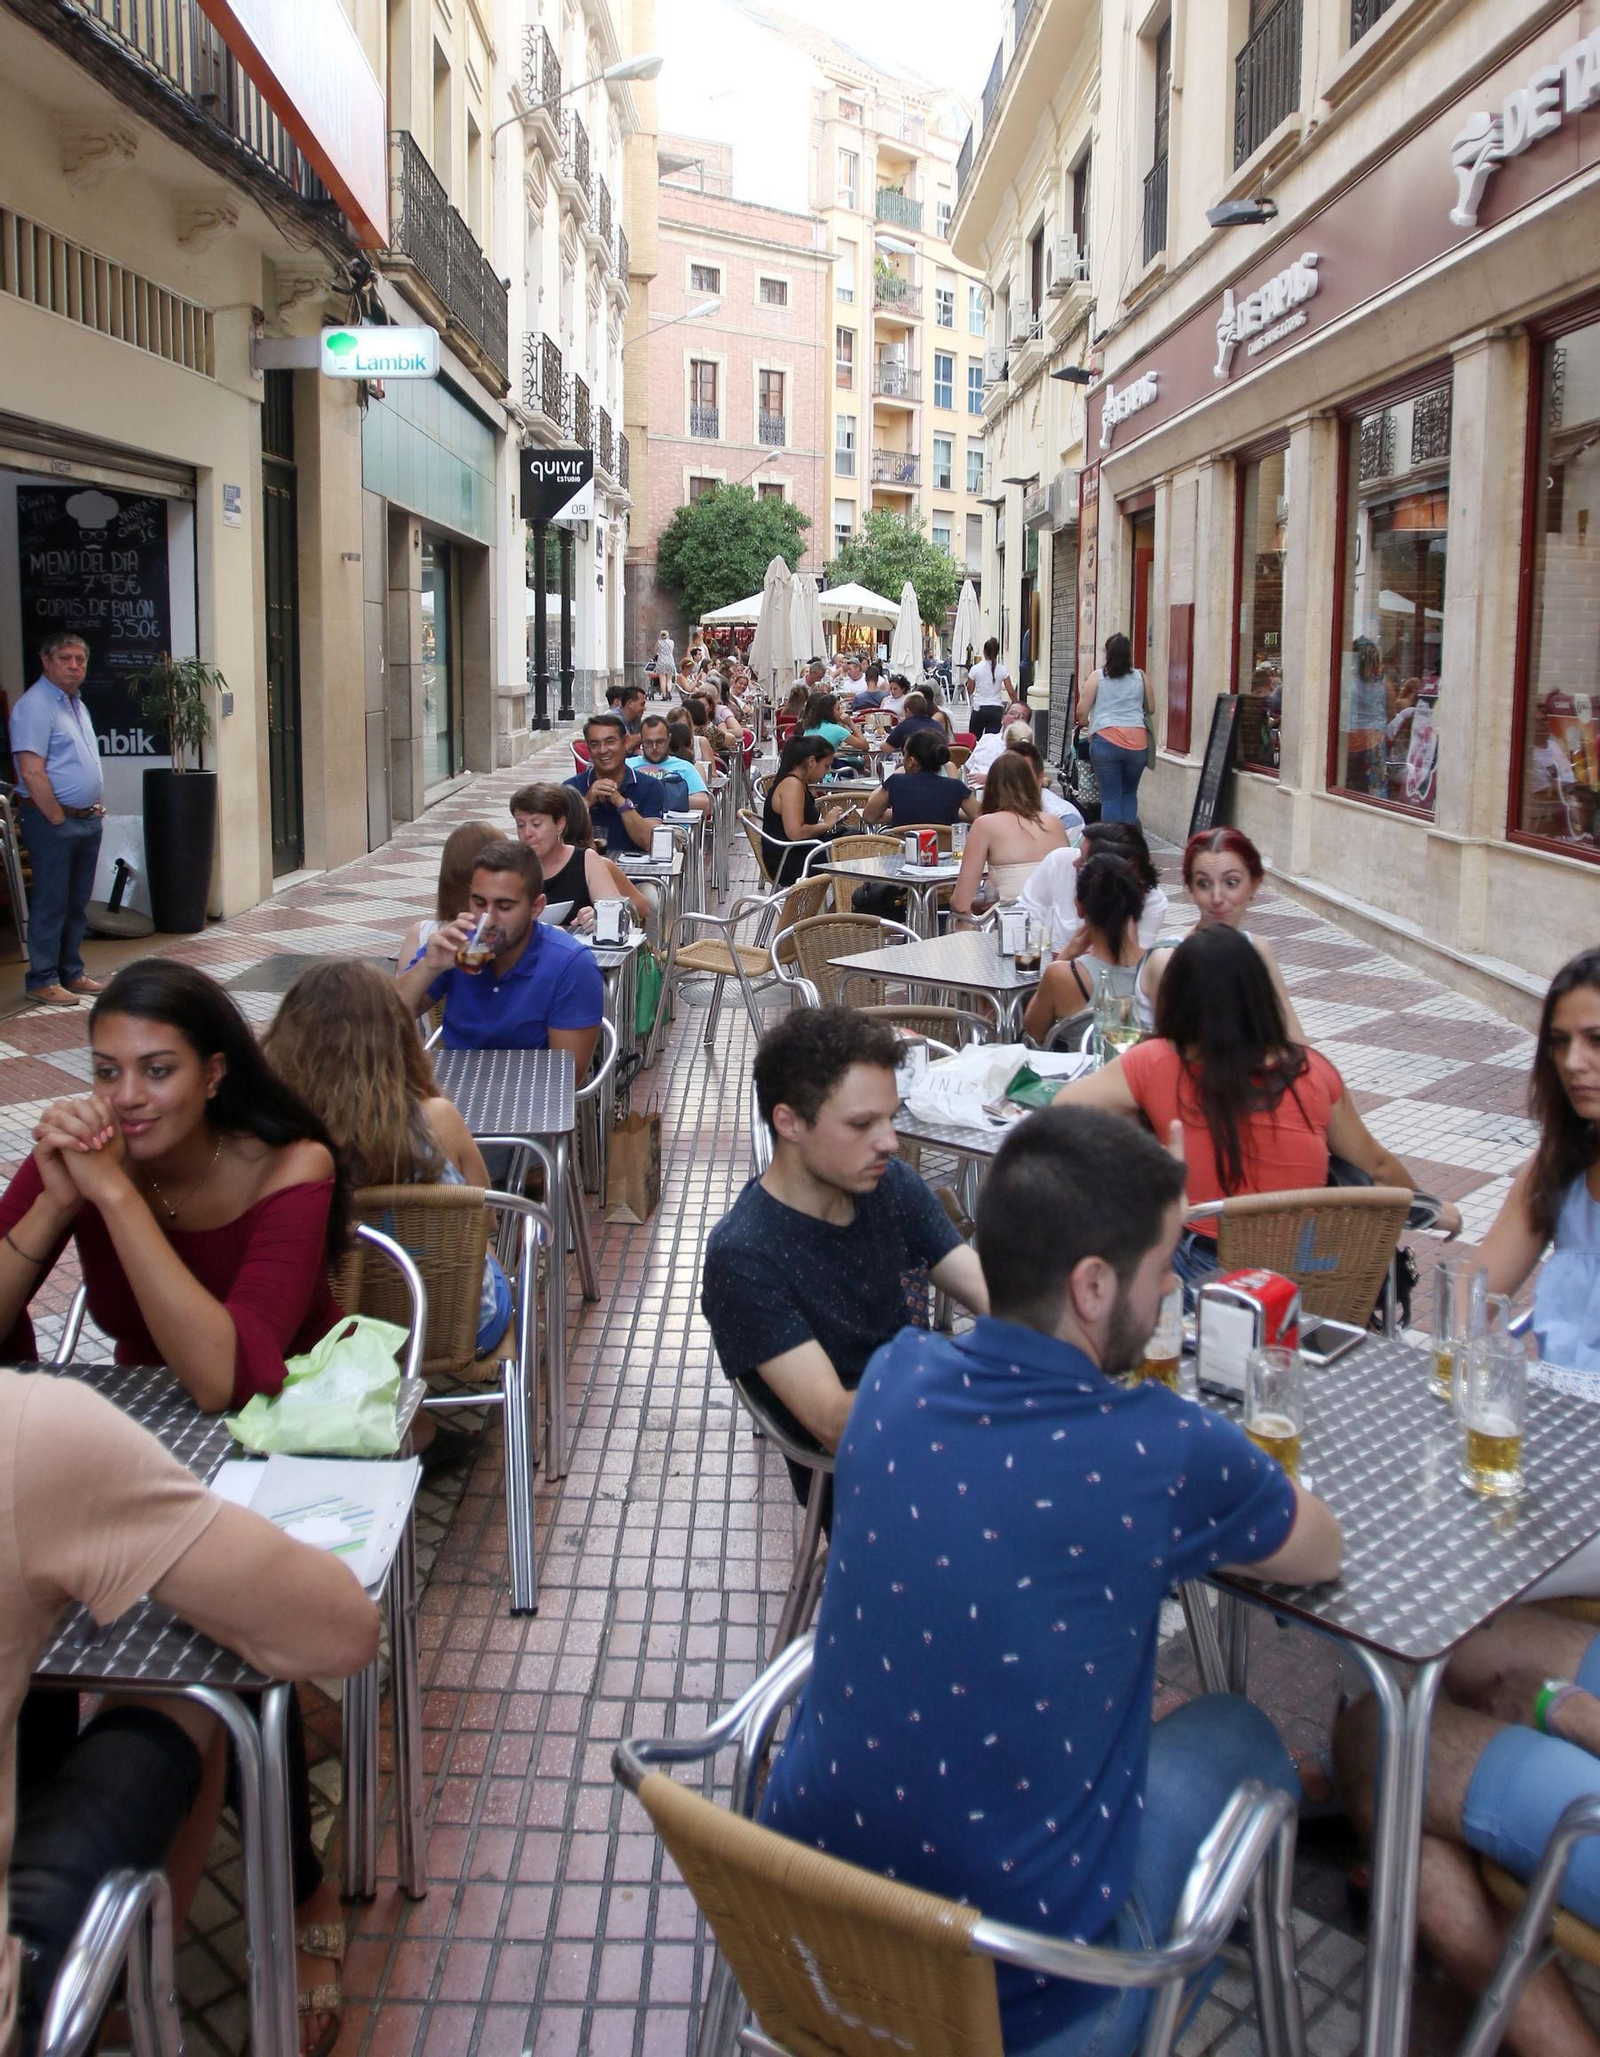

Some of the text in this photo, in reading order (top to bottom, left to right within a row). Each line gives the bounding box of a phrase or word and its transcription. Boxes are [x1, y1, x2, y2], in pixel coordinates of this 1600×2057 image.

[355, 353, 427, 371] Lambik
[556, 475, 582, 483] ESTUDIO
[80, 550, 107, 573] DEL
[36, 598, 86, 618] COPAS
[89, 598, 110, 617] DE
